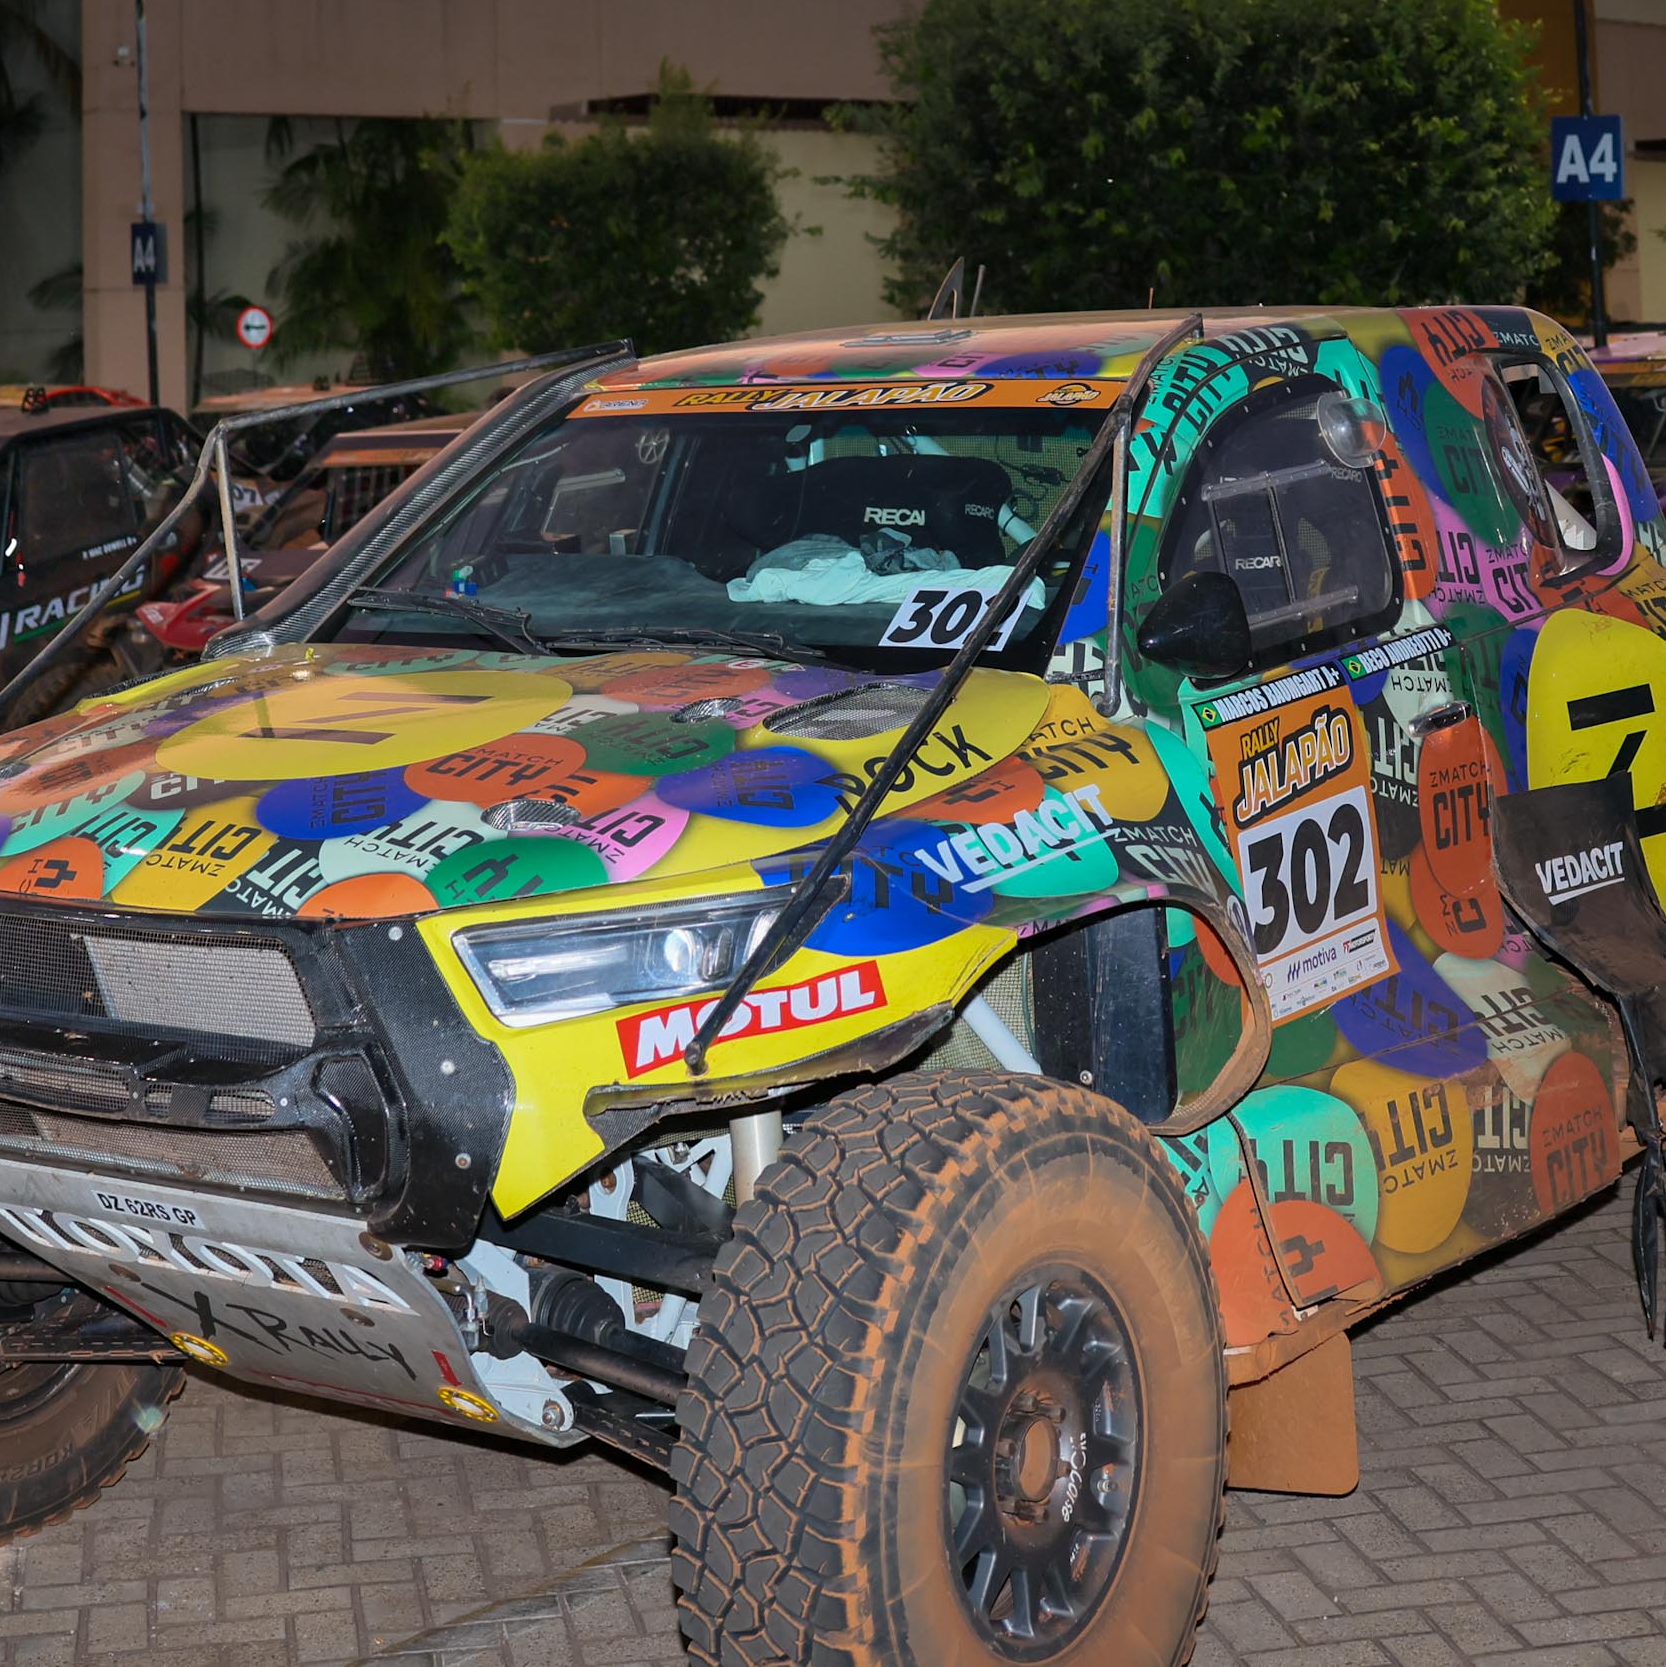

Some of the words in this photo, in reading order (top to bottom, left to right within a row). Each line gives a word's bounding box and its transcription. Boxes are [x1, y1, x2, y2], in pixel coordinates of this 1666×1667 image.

[1556, 132, 1618, 184] A4
[133, 235, 156, 273] A4
[675, 389, 779, 407] RALLY
[752, 380, 989, 411] JALAPÃO
[1386, 630, 1442, 666] ANDREOTTI
[1212, 689, 1267, 723] MARCOS
[1261, 668, 1325, 712] BAUMGART
[1320, 665, 1340, 691] A+
[1241, 717, 1280, 762] RALLY
[426, 753, 553, 785] CITY
[1236, 713, 1352, 823] JALAPÃO
[914, 783, 1116, 884] VEDACIT
[1247, 803, 1370, 955] 302
[1534, 841, 1625, 895] VEDACIT
[1302, 946, 1338, 973] motiva
[635, 969, 876, 1070] MOTUL
[96, 1192, 128, 1215] DZ
[128, 1197, 171, 1223] 62RS
[172, 1206, 199, 1227] GP
[225, 1302, 418, 1382] RALLY
